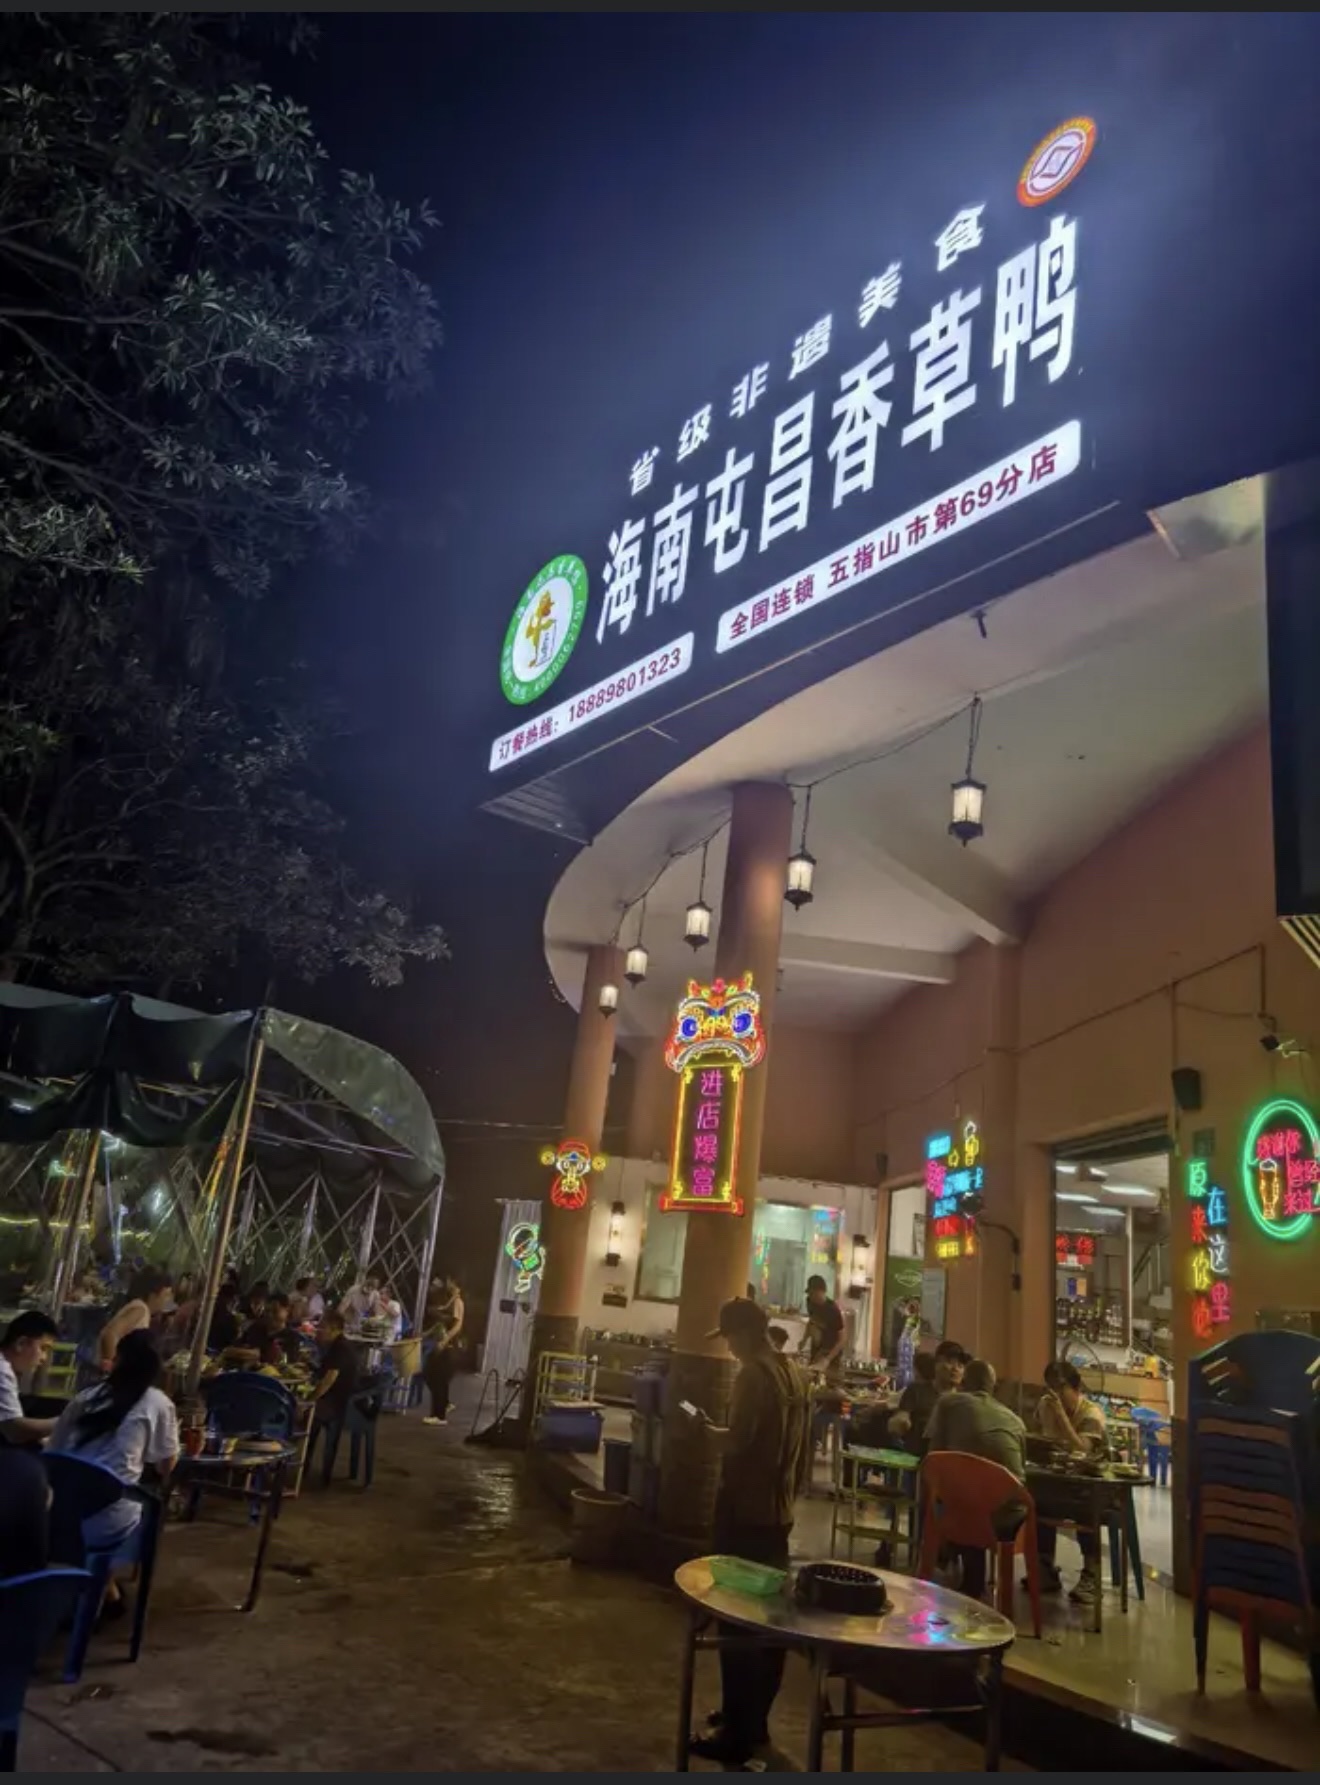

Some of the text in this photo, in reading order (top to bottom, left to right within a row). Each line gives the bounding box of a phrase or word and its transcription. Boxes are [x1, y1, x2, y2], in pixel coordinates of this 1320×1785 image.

[596, 214, 1077, 644] 海南屯昌香草鸭
[628, 204, 985, 496] 省级非遗美食
[730, 444, 1057, 639] 全国连锁 五指山市第69分店
[568, 648, 680, 722] 18889801323
[1207, 1186, 1231, 1323] 在这里
